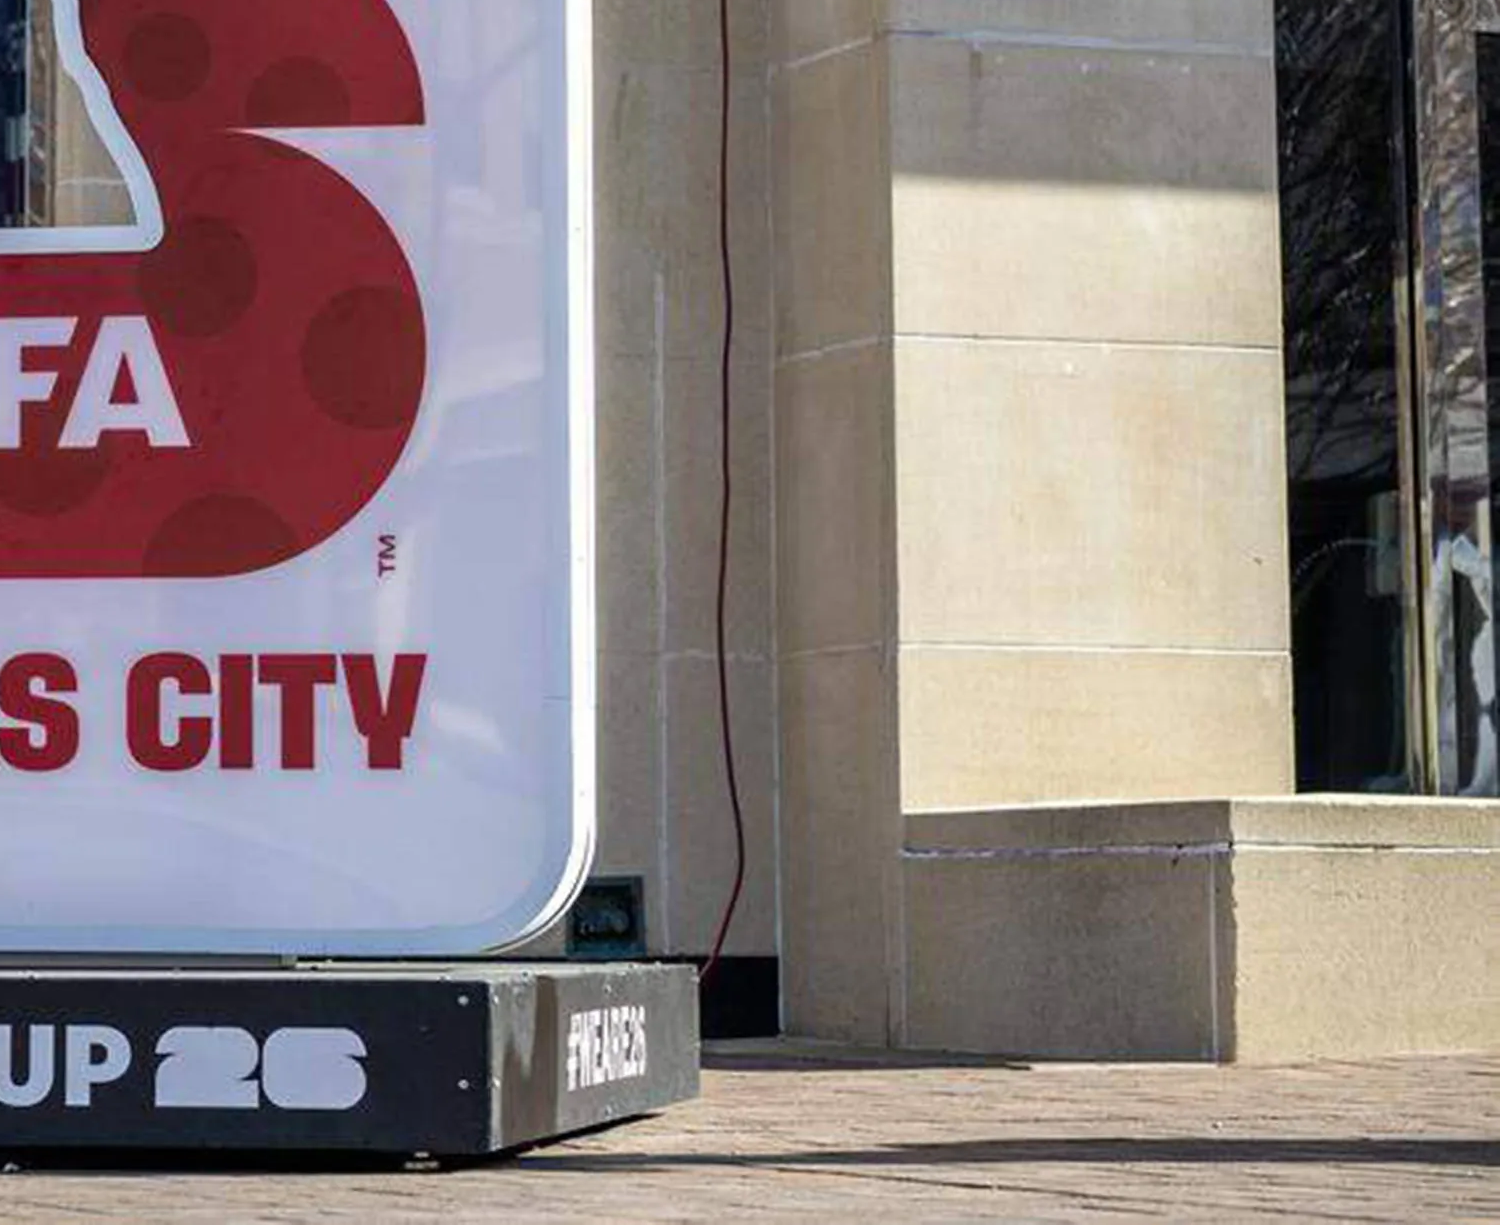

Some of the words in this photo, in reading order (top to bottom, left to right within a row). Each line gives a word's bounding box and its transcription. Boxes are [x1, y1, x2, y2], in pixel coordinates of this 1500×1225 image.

[377, 534, 396, 579] TM
[126, 652, 428, 770] CITY
[154, 1025, 368, 1110] 26
